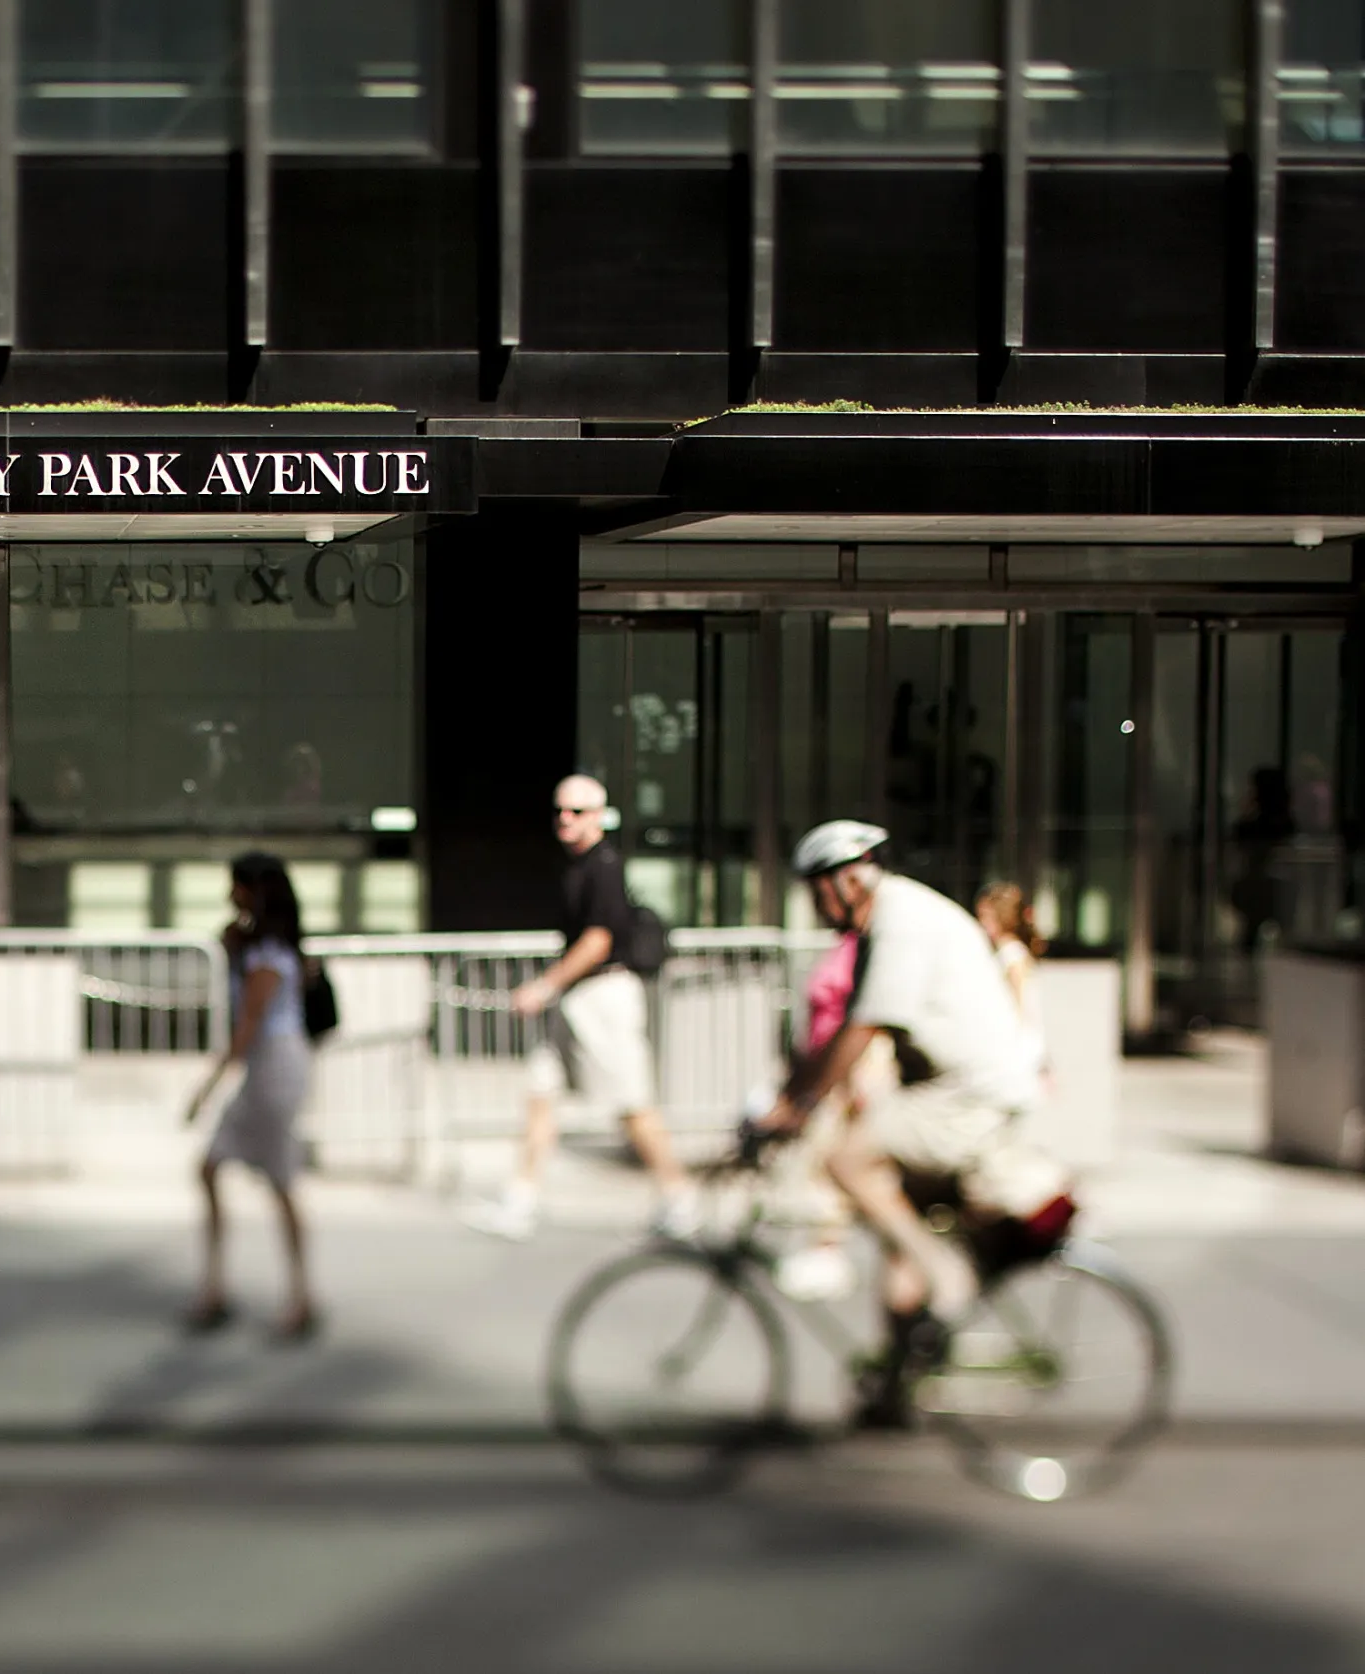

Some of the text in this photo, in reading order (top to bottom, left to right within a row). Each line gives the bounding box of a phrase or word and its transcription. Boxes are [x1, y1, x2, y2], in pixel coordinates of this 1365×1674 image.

[37, 453, 187, 496] PARK
[198, 452, 430, 496] AVENUE
[235, 549, 293, 606] &
